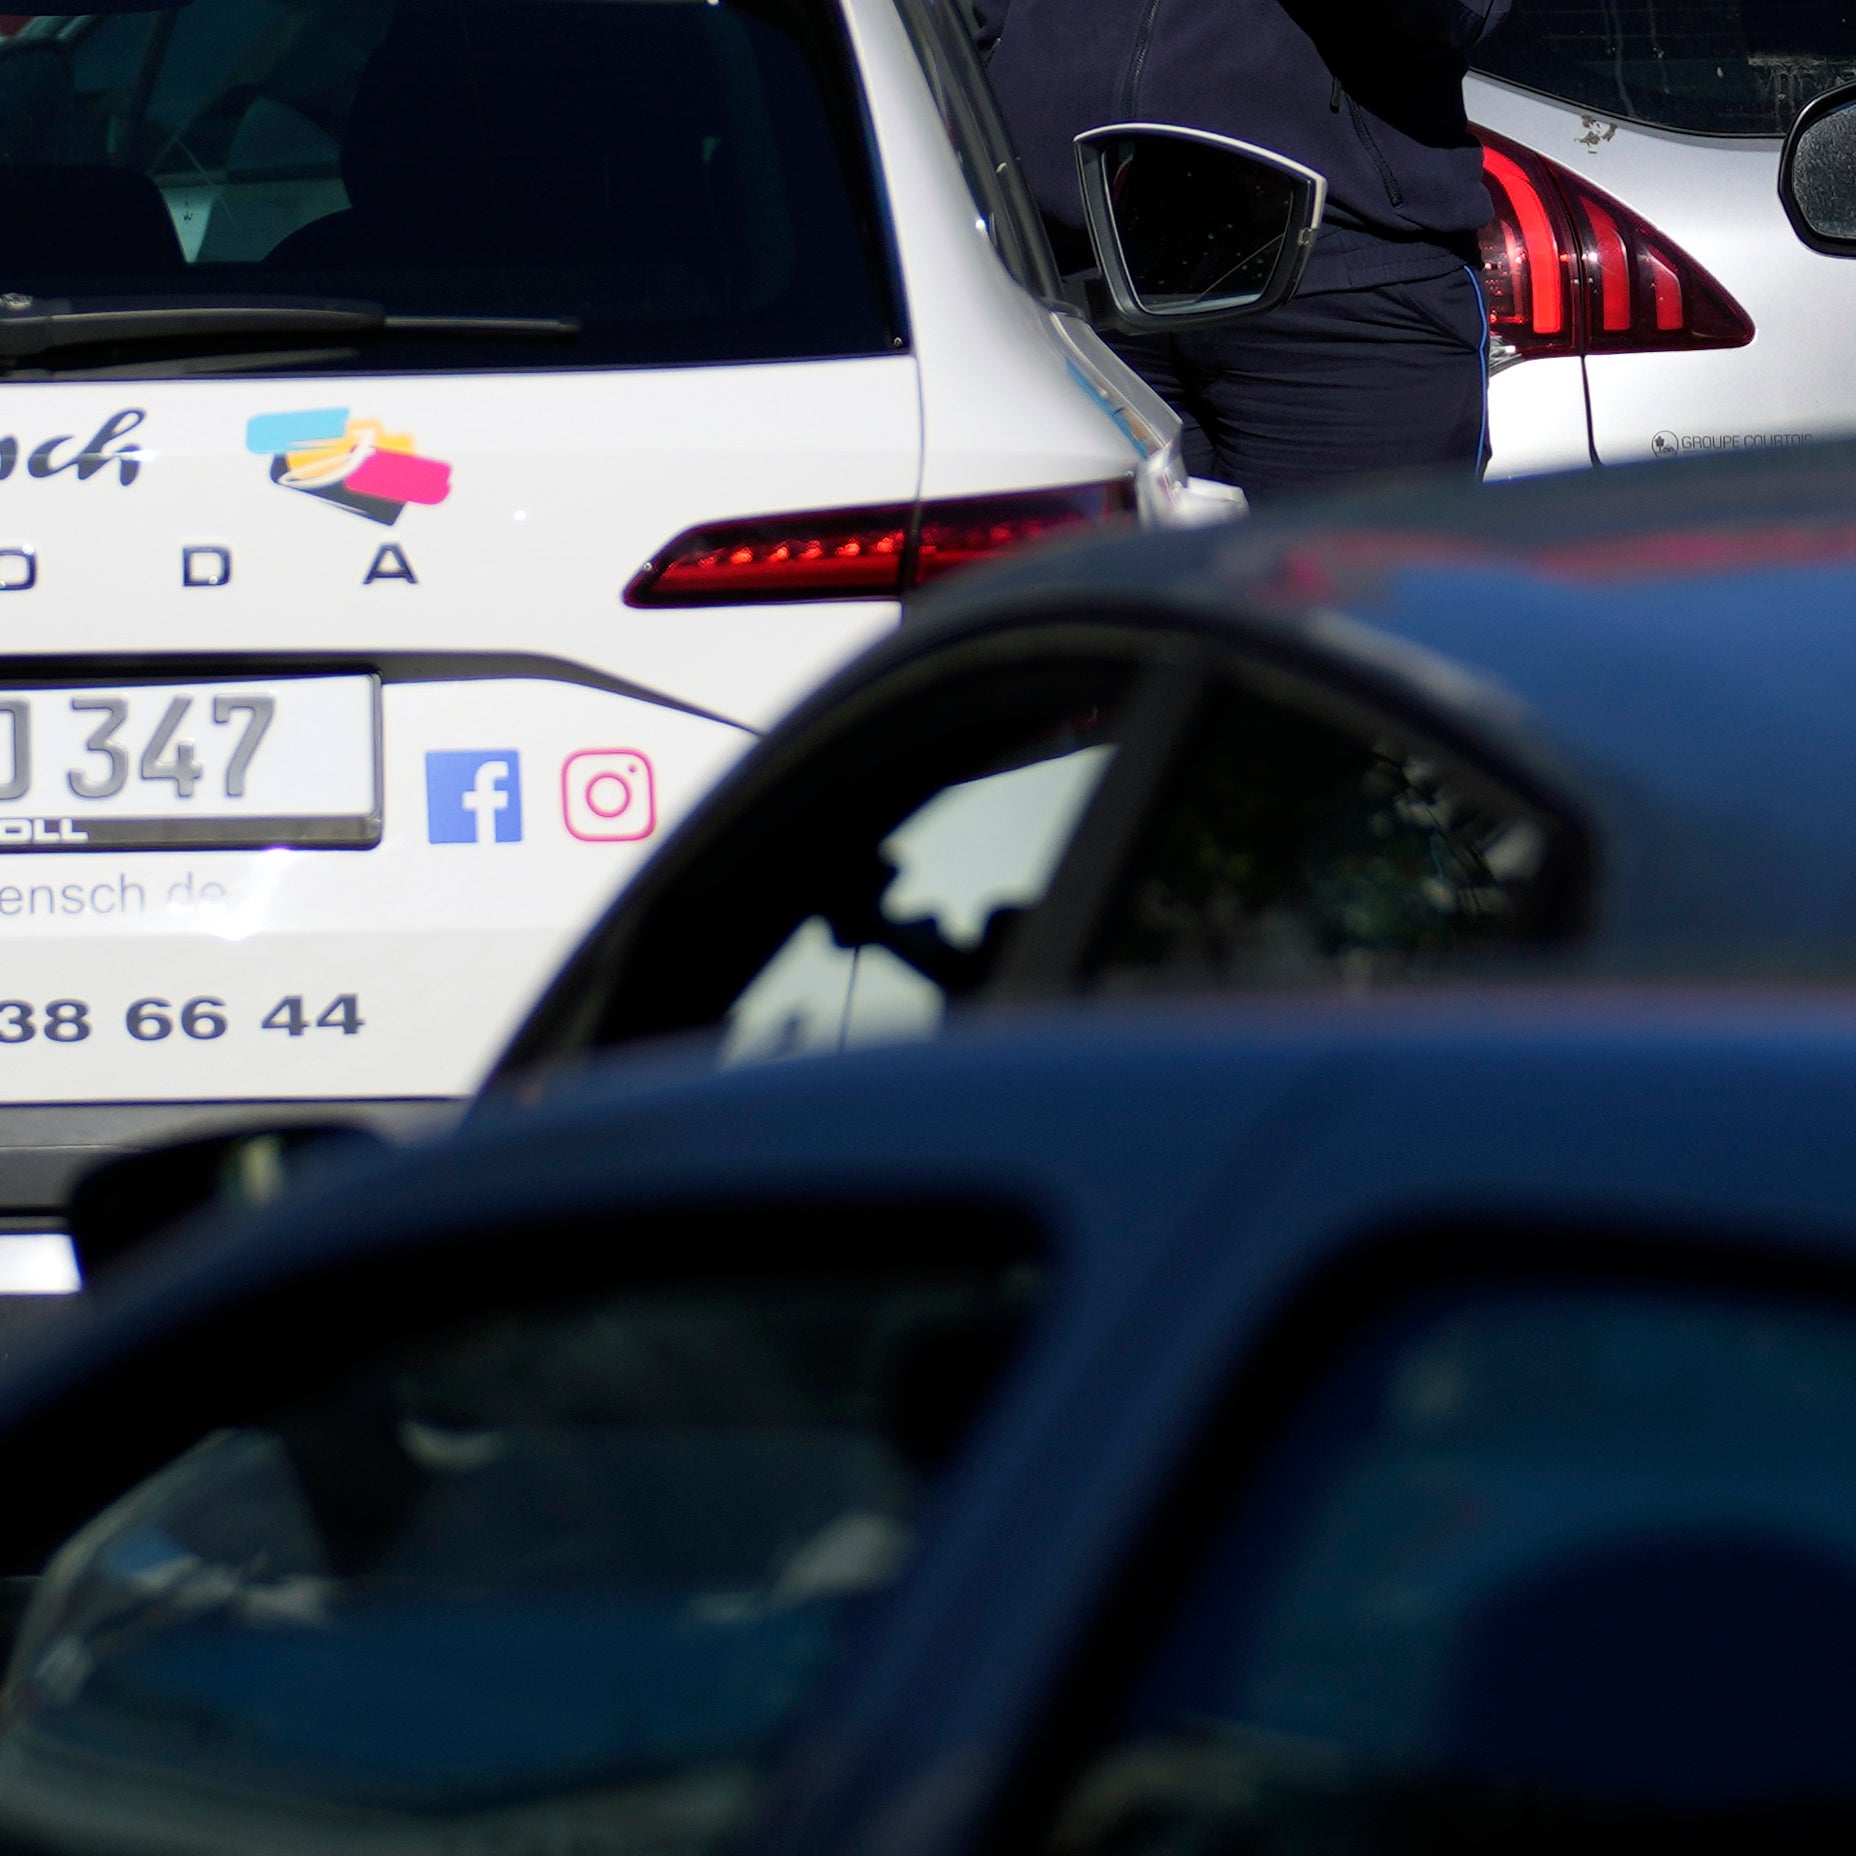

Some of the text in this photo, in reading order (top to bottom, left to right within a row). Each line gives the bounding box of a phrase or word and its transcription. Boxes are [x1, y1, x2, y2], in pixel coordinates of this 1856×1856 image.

[1681, 434, 1741, 450] GROUPE
[65, 693, 278, 800] 347
[124, 996, 228, 1044] 66
[259, 993, 366, 1039] 44
